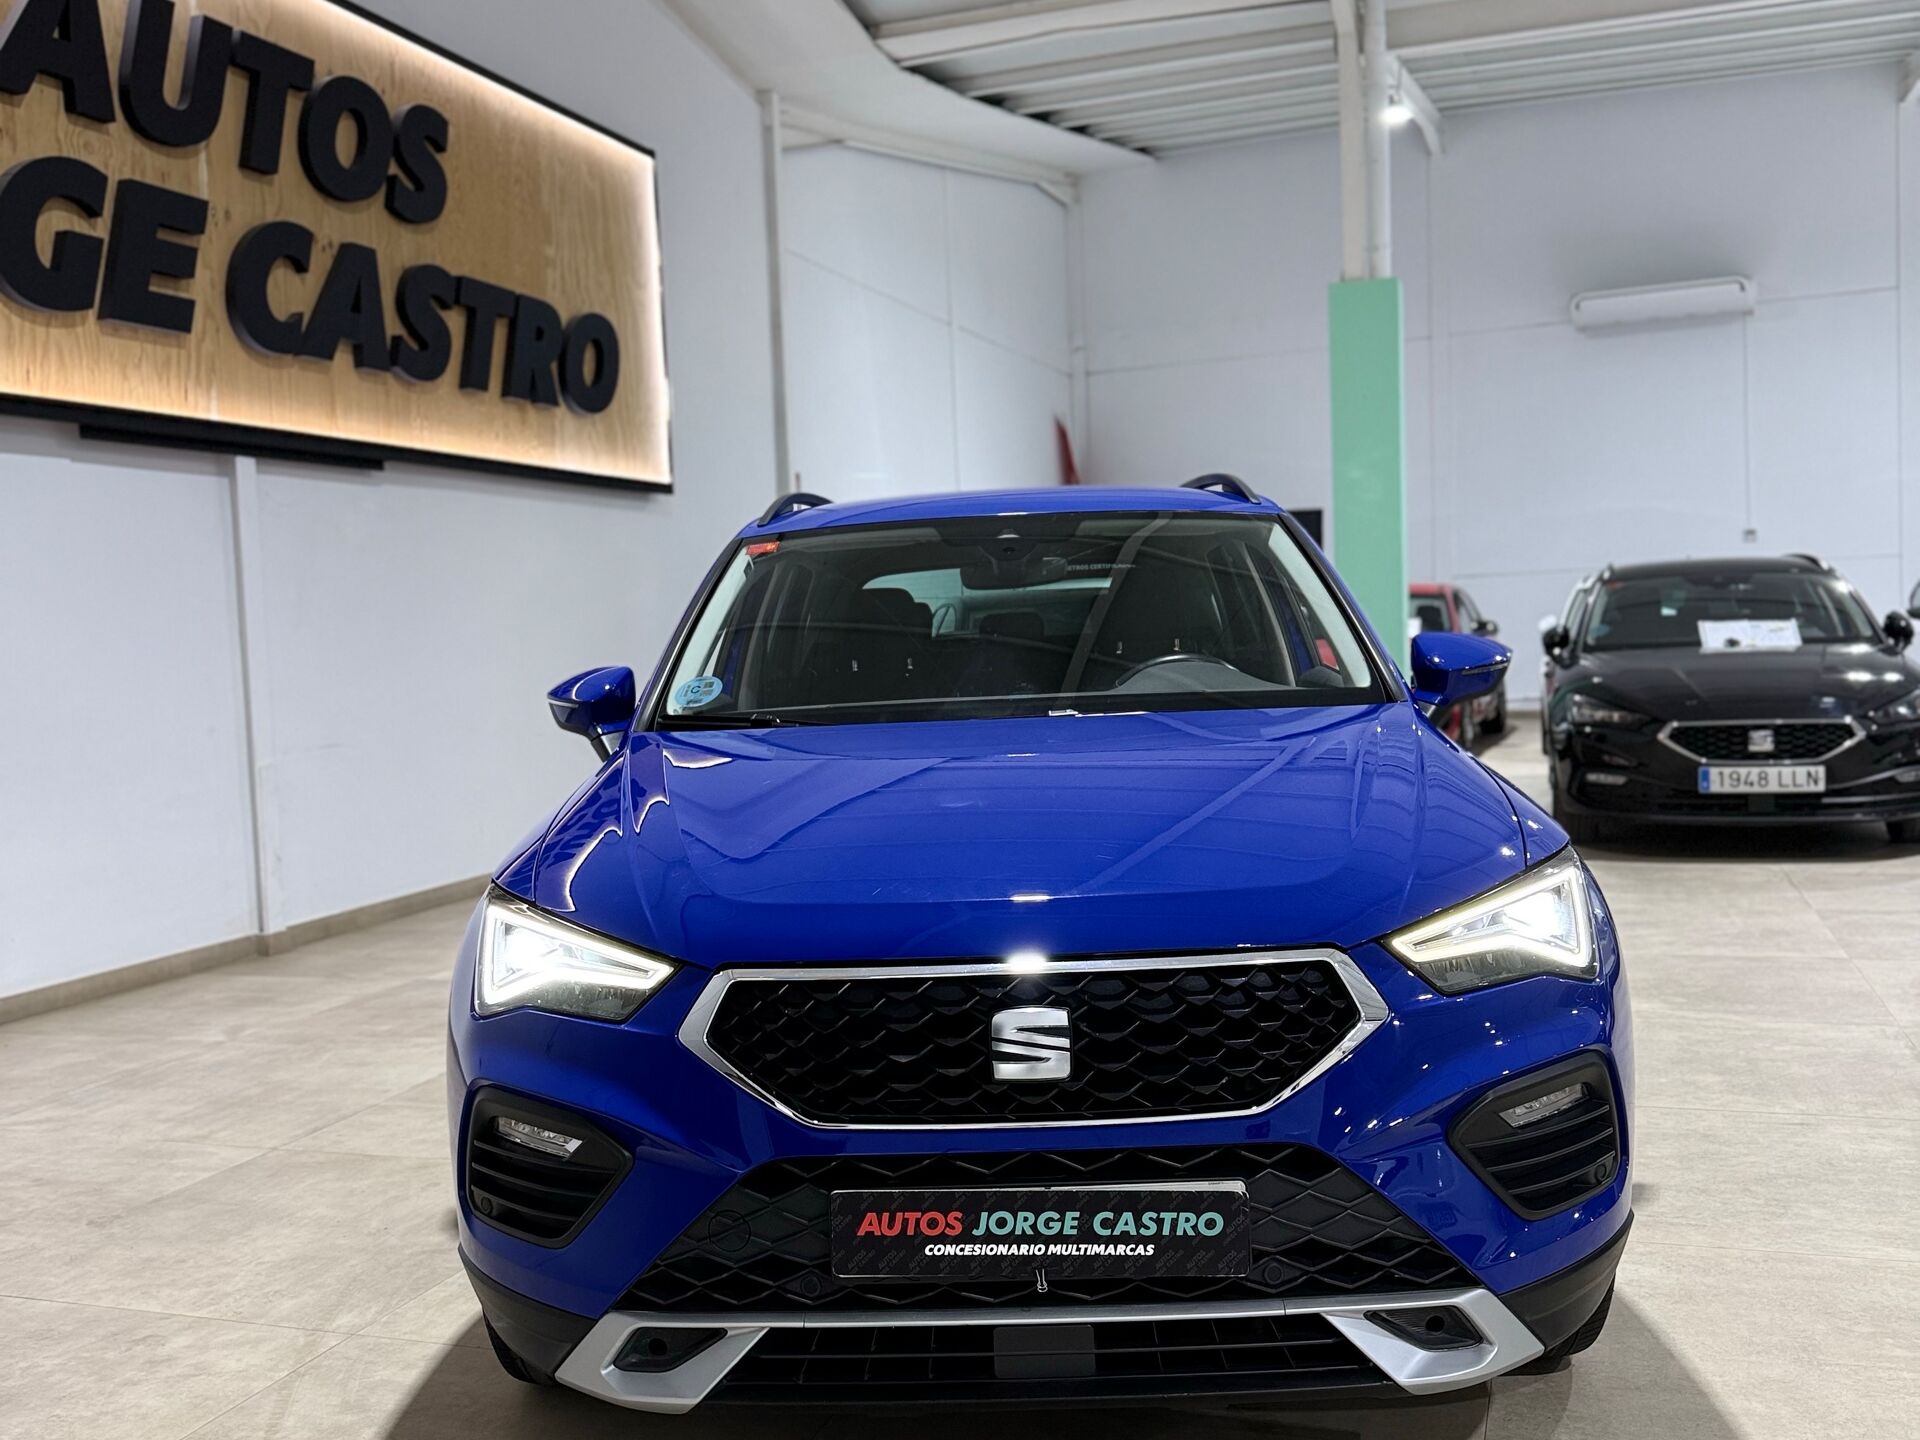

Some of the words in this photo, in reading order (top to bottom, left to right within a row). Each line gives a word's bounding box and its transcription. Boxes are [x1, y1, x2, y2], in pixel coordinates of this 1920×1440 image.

[0, 0, 450, 224] AUTOS
[226, 220, 620, 415] CASTRO
[1717, 770, 1770, 789] 1948
[1777, 769, 1820, 789] LLN
[856, 1211, 963, 1236] AUTOS
[971, 1211, 1080, 1236] JORGE
[1092, 1211, 1224, 1236] CASTRO
[924, 1243, 1046, 1257] CONCESIONARIO
[1047, 1243, 1155, 1257] MULTIMARCAS
